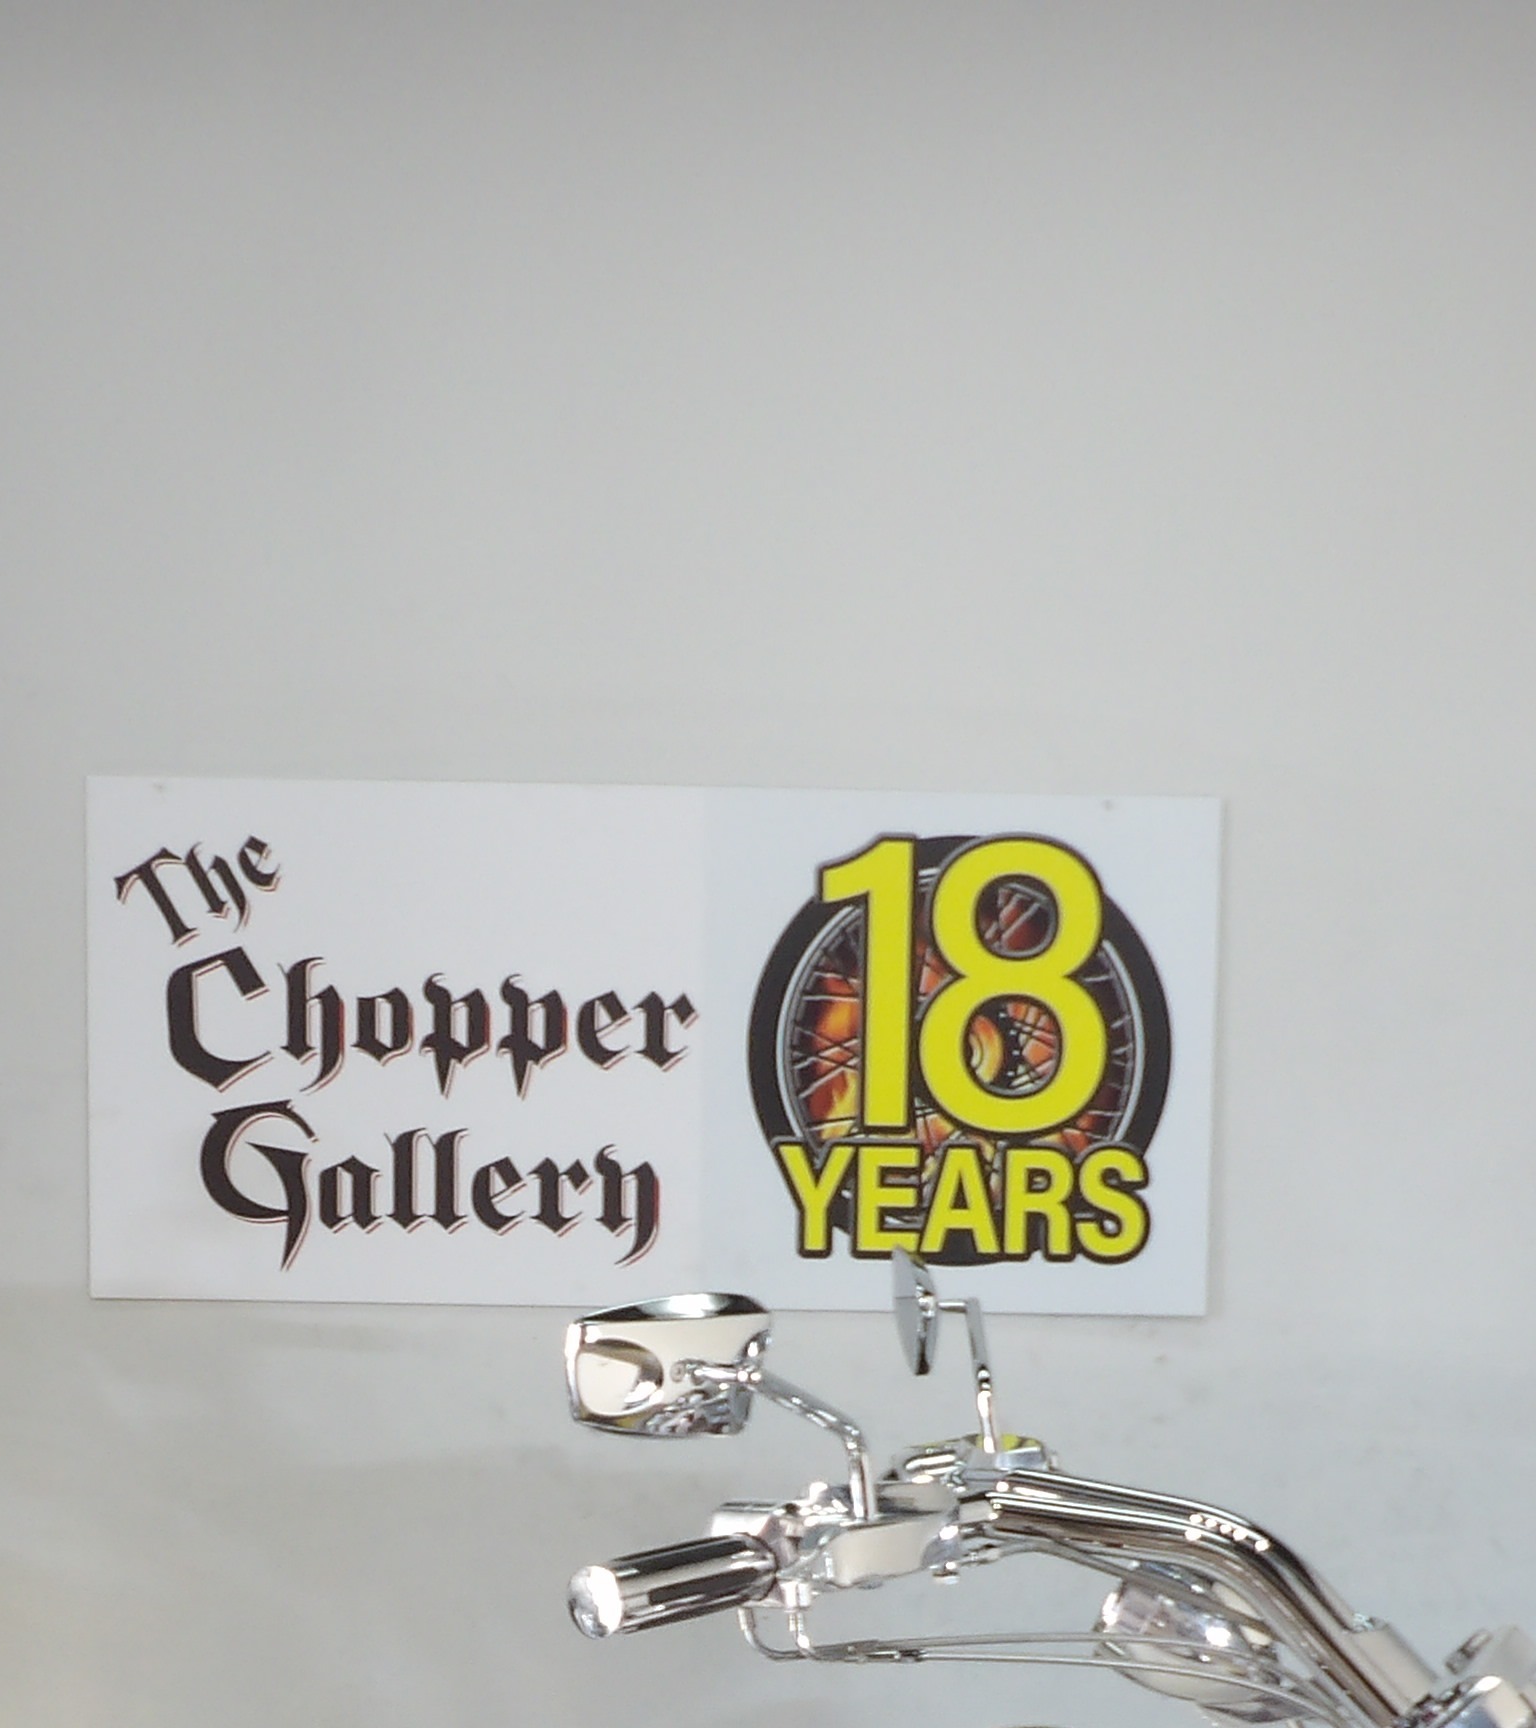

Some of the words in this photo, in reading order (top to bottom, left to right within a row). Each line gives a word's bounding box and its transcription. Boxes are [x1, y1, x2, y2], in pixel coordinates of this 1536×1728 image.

[112, 834, 282, 946] The
[165, 945, 699, 1098] Chopper
[818, 834, 1109, 1135] 18
[198, 1098, 662, 1269] Gallery
[777, 1139, 1152, 1260] YEARS
